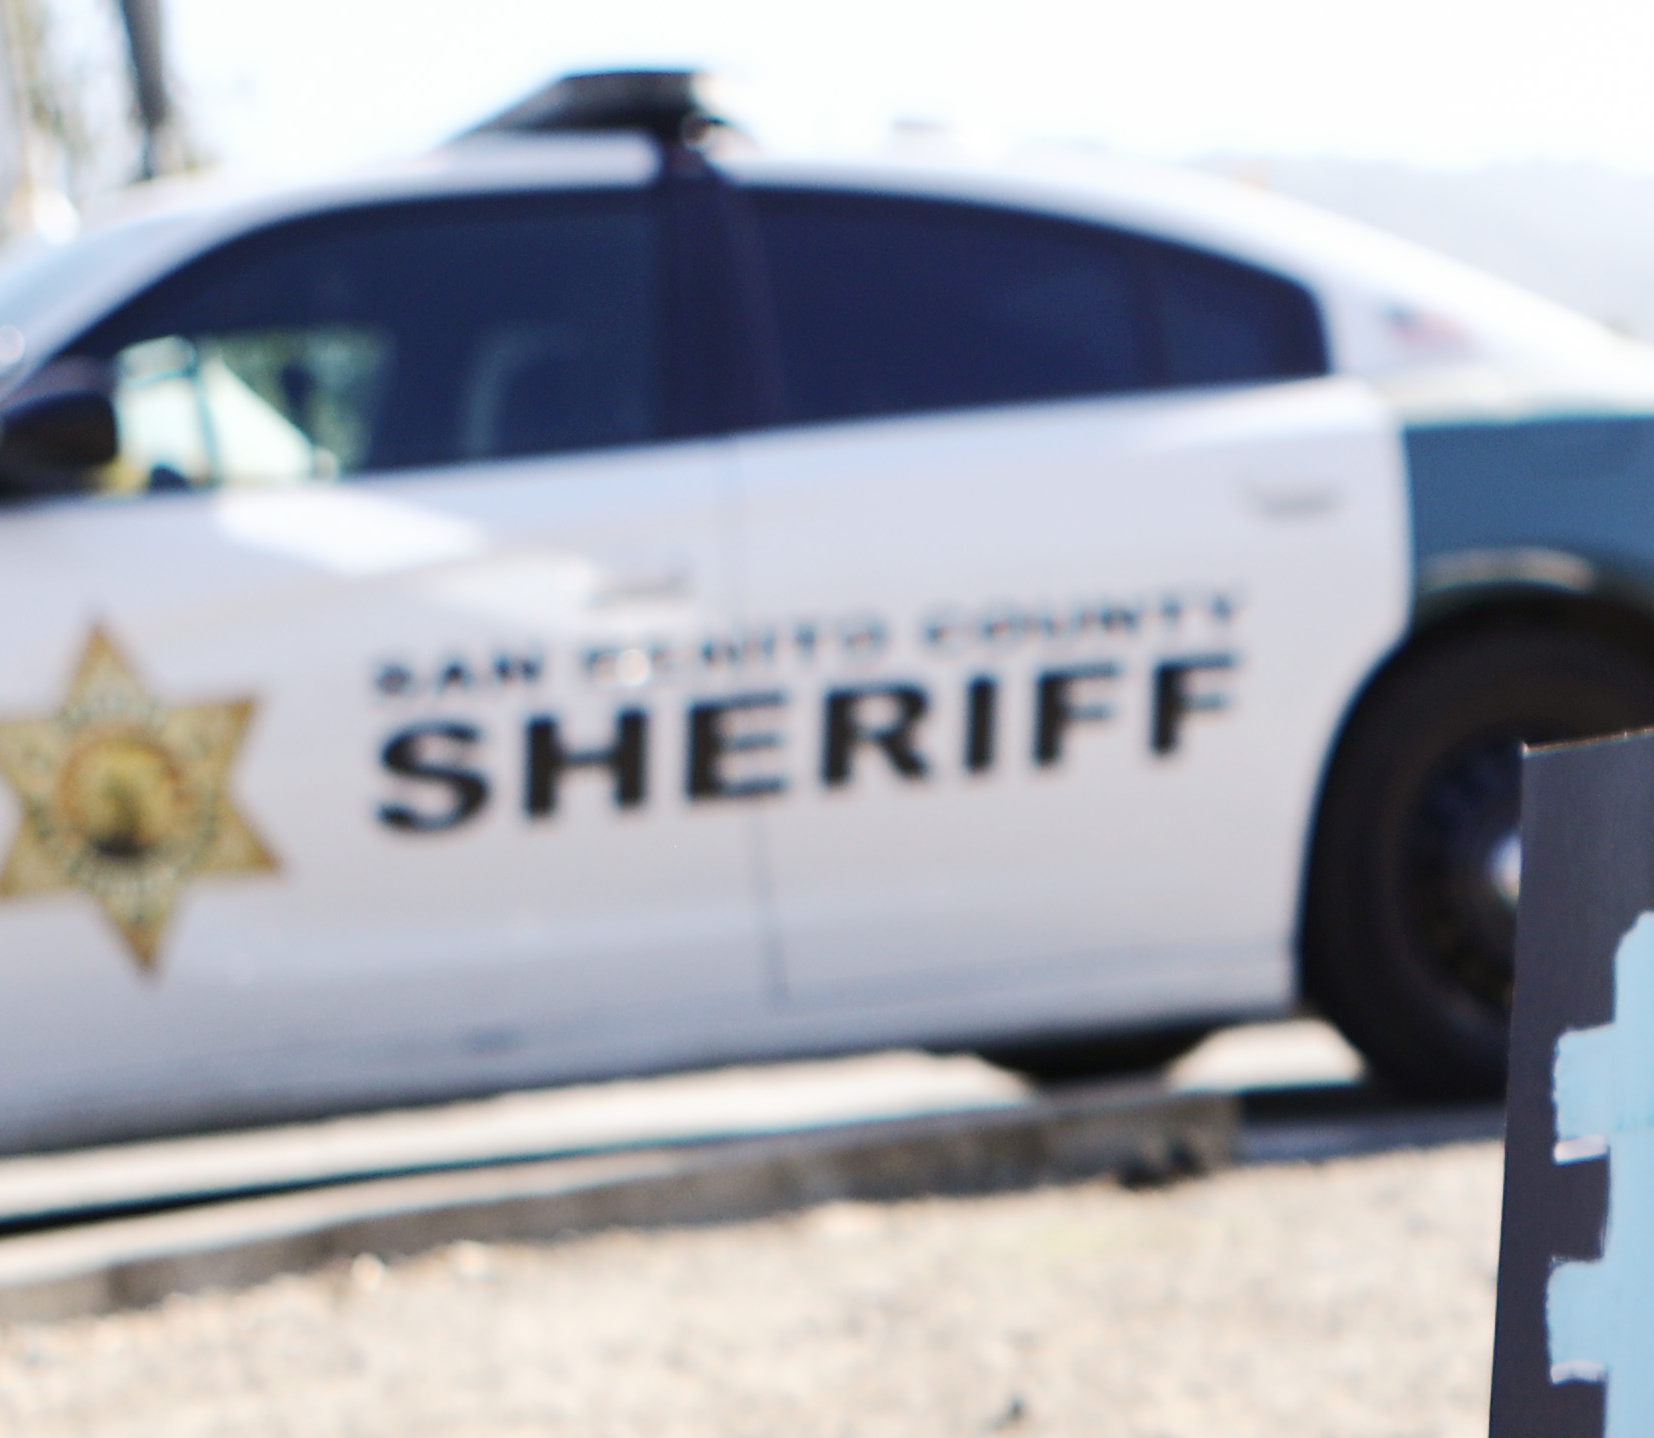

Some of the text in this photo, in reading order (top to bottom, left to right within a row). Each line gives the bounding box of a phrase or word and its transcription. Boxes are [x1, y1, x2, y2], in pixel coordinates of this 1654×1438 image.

[370, 646, 544, 701] SAN
[922, 588, 1242, 653] COUNTY
[372, 650, 1240, 834] SHERIFF
